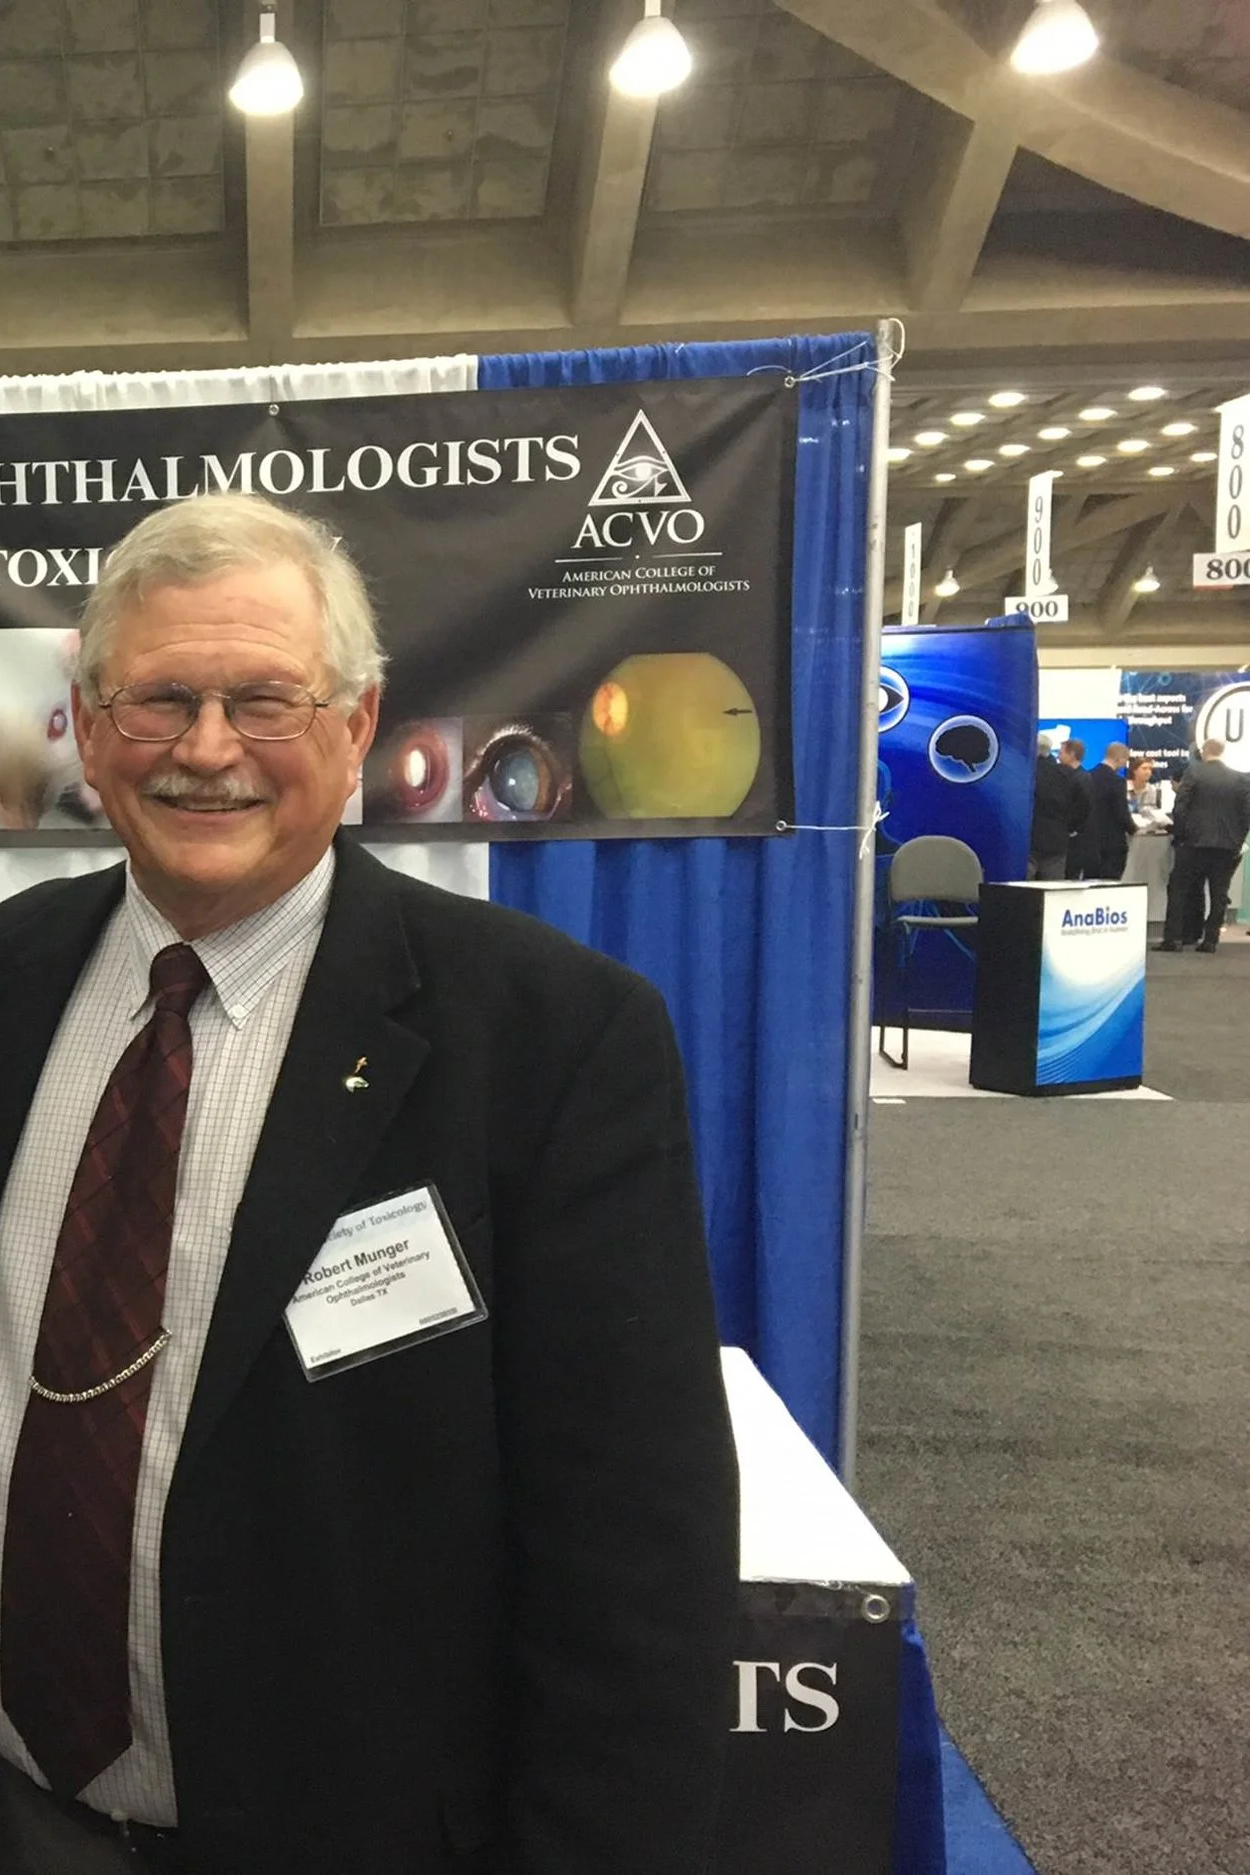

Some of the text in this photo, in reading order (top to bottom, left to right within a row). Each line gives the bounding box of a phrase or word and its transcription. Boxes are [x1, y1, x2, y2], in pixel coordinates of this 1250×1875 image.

[1228, 424, 1245, 539] 800
[571, 508, 705, 548] ACVO
[1032, 496, 1043, 586] 900
[1062, 905, 1127, 927] AnaBios
[368, 1201, 428, 1226] Toxicology
[303, 1239, 409, 1285] Robert Munger
